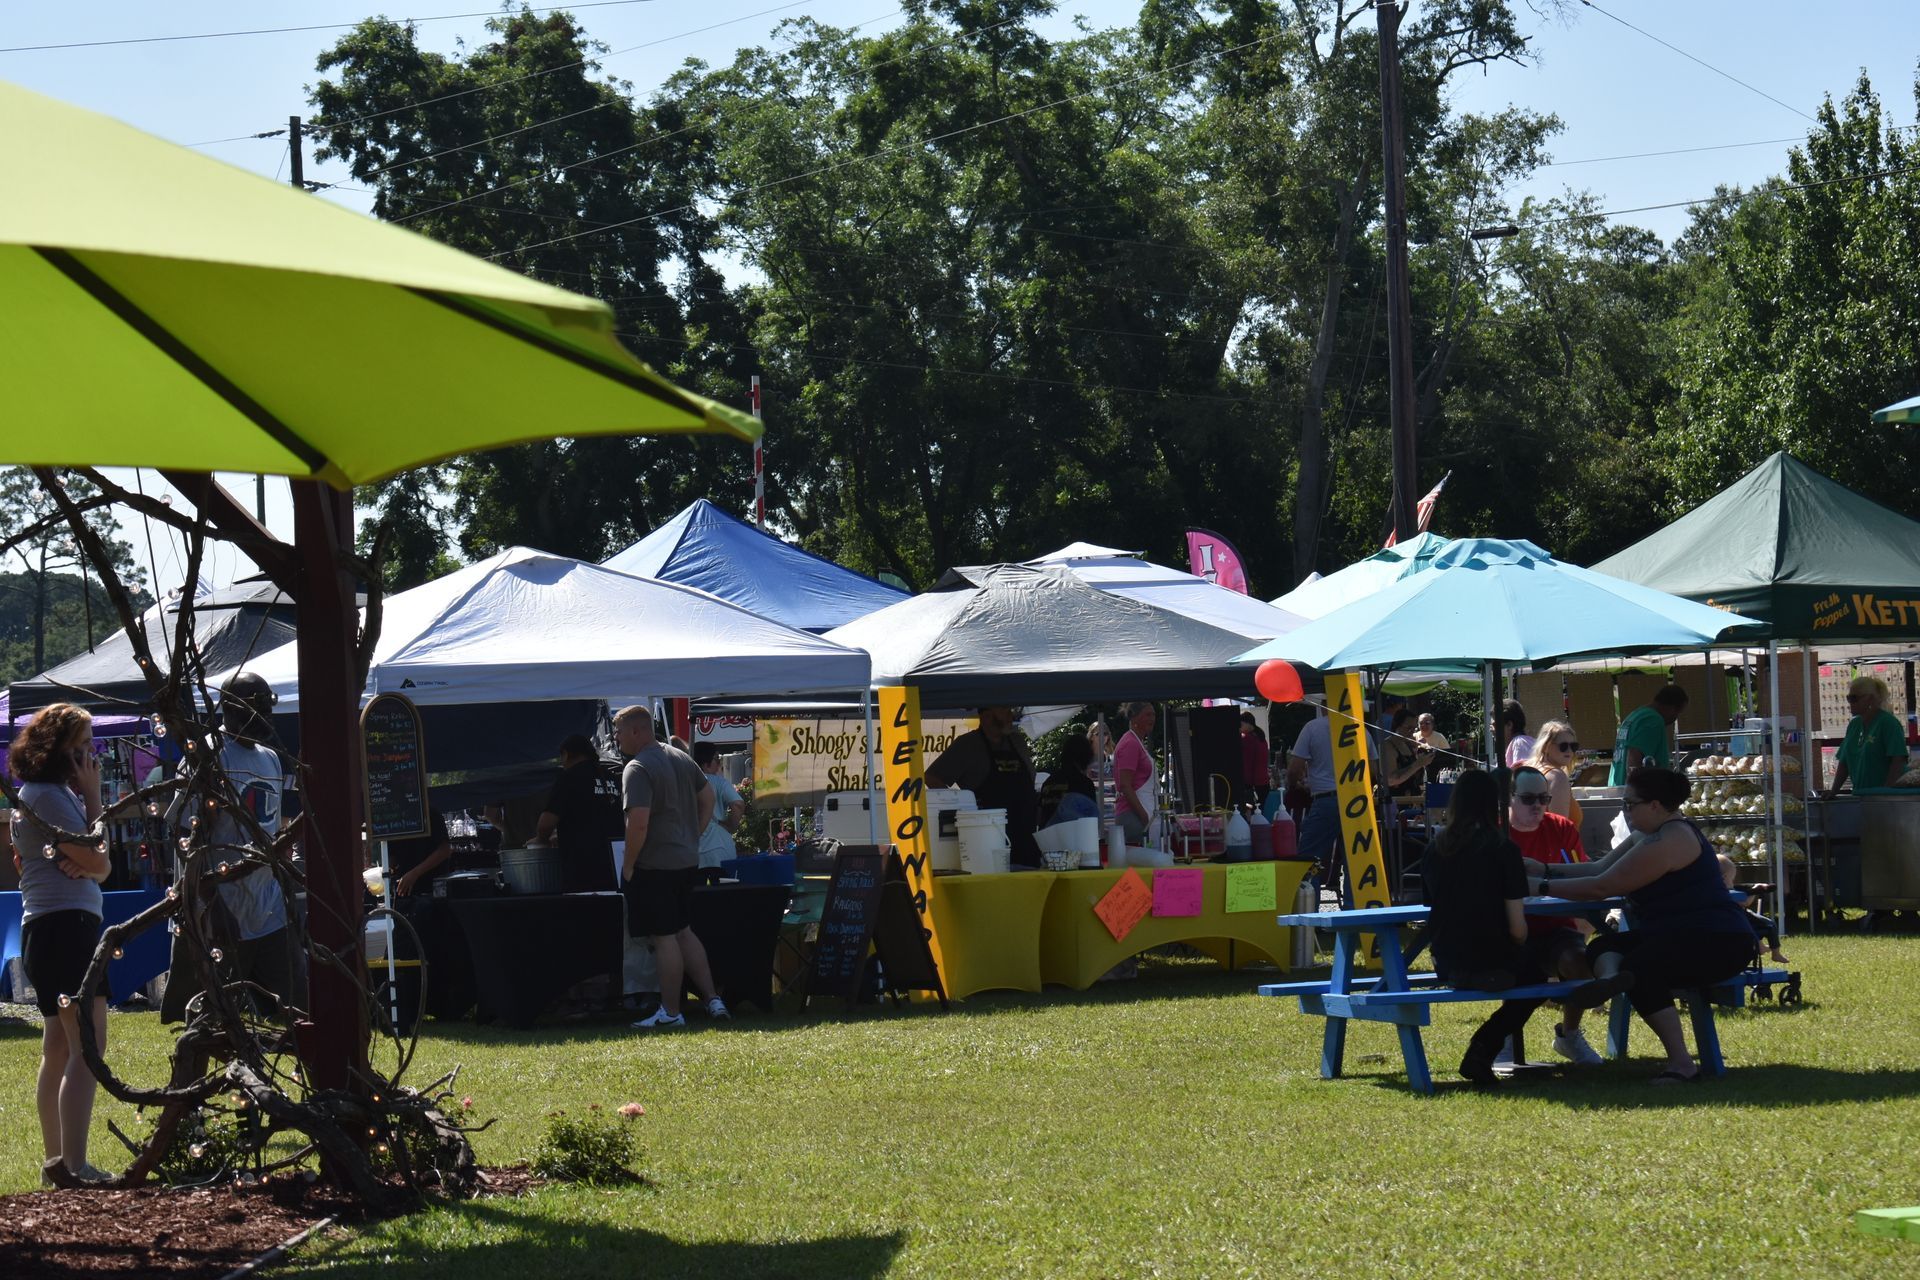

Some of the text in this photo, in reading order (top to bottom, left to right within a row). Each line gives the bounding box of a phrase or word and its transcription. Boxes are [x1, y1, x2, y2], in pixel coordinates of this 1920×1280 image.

[1812, 603, 1850, 630] Popped
[1813, 592, 1840, 614] Fresh
[791, 725, 868, 760] Shoogy's
